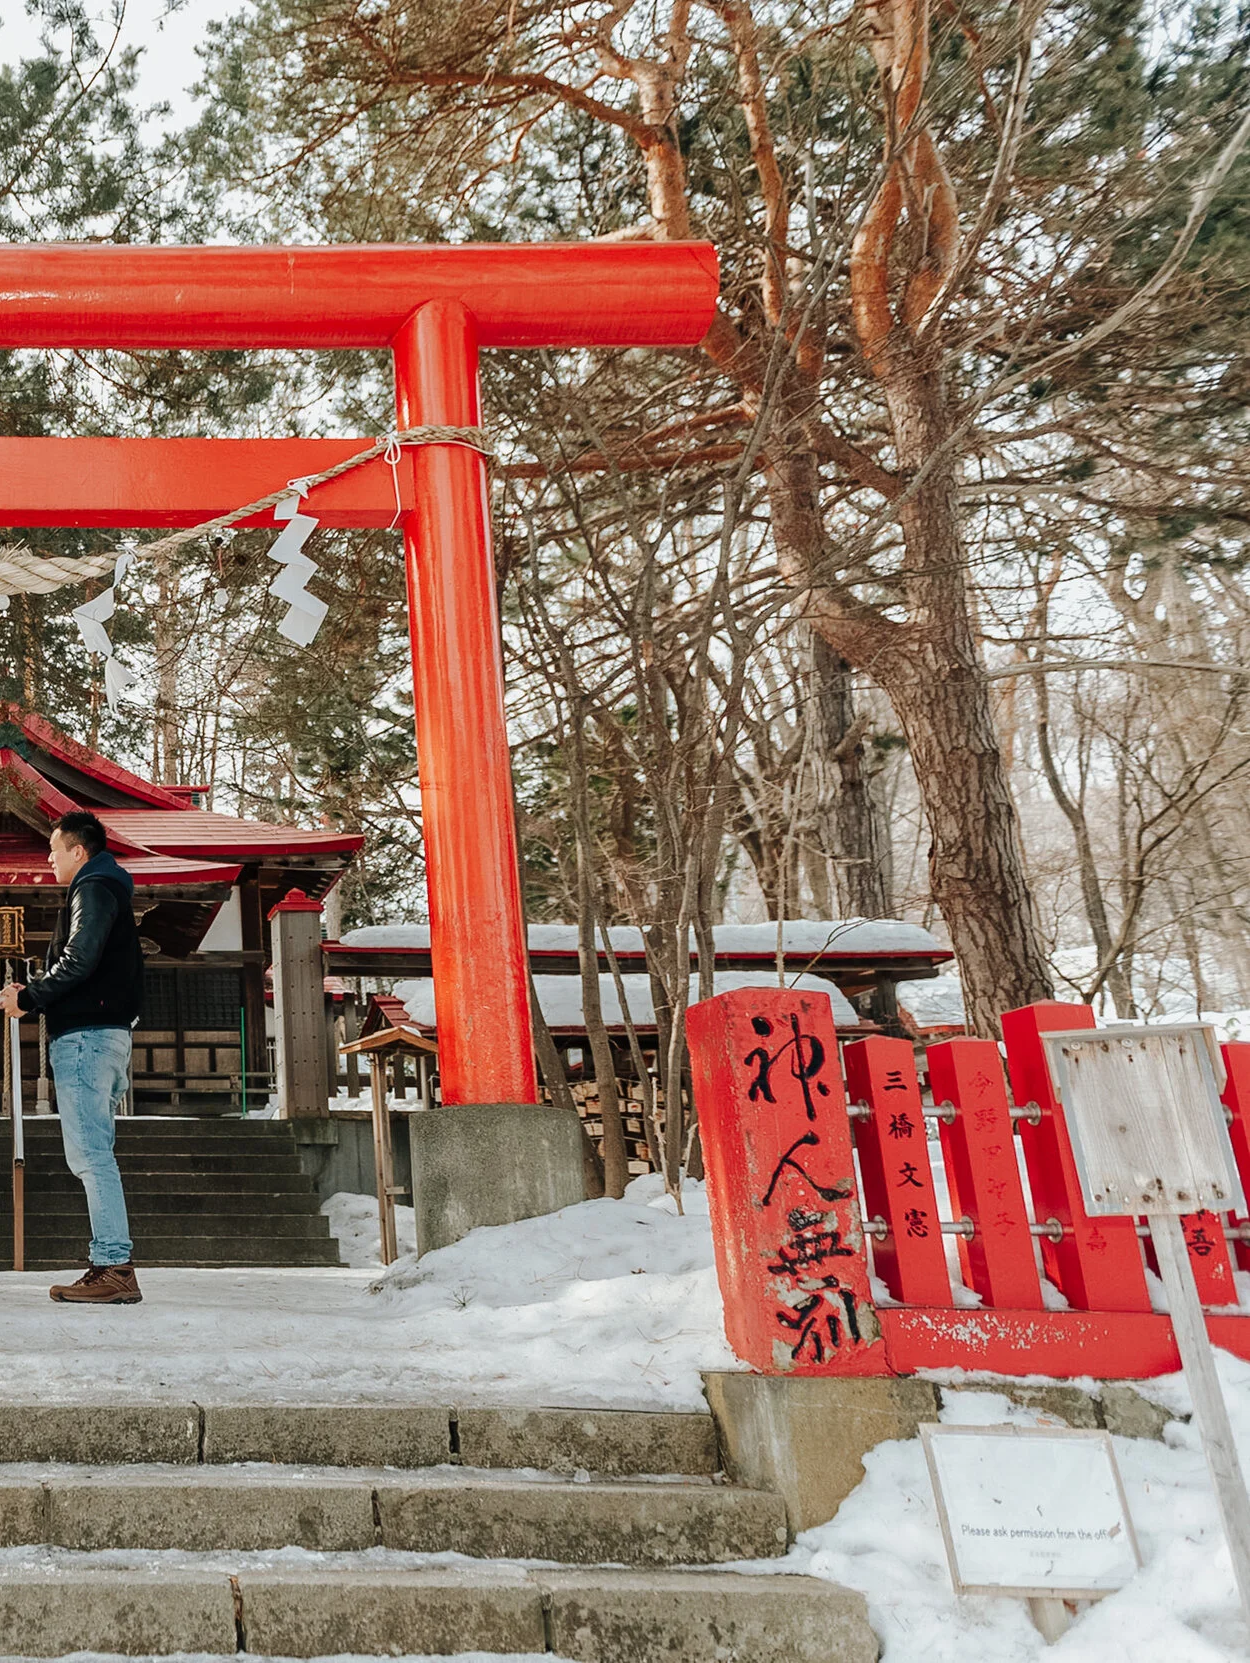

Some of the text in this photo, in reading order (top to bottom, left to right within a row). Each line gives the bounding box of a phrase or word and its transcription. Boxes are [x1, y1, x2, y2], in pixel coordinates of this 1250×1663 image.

[882, 1070, 929, 1239] 三橋文憲
[961, 1524, 991, 1537] Please
[993, 1526, 1007, 1538] ask
[1010, 1527, 1056, 1540] permission
[1057, 1527, 1077, 1540] from
[1078, 1528, 1092, 1540] the
